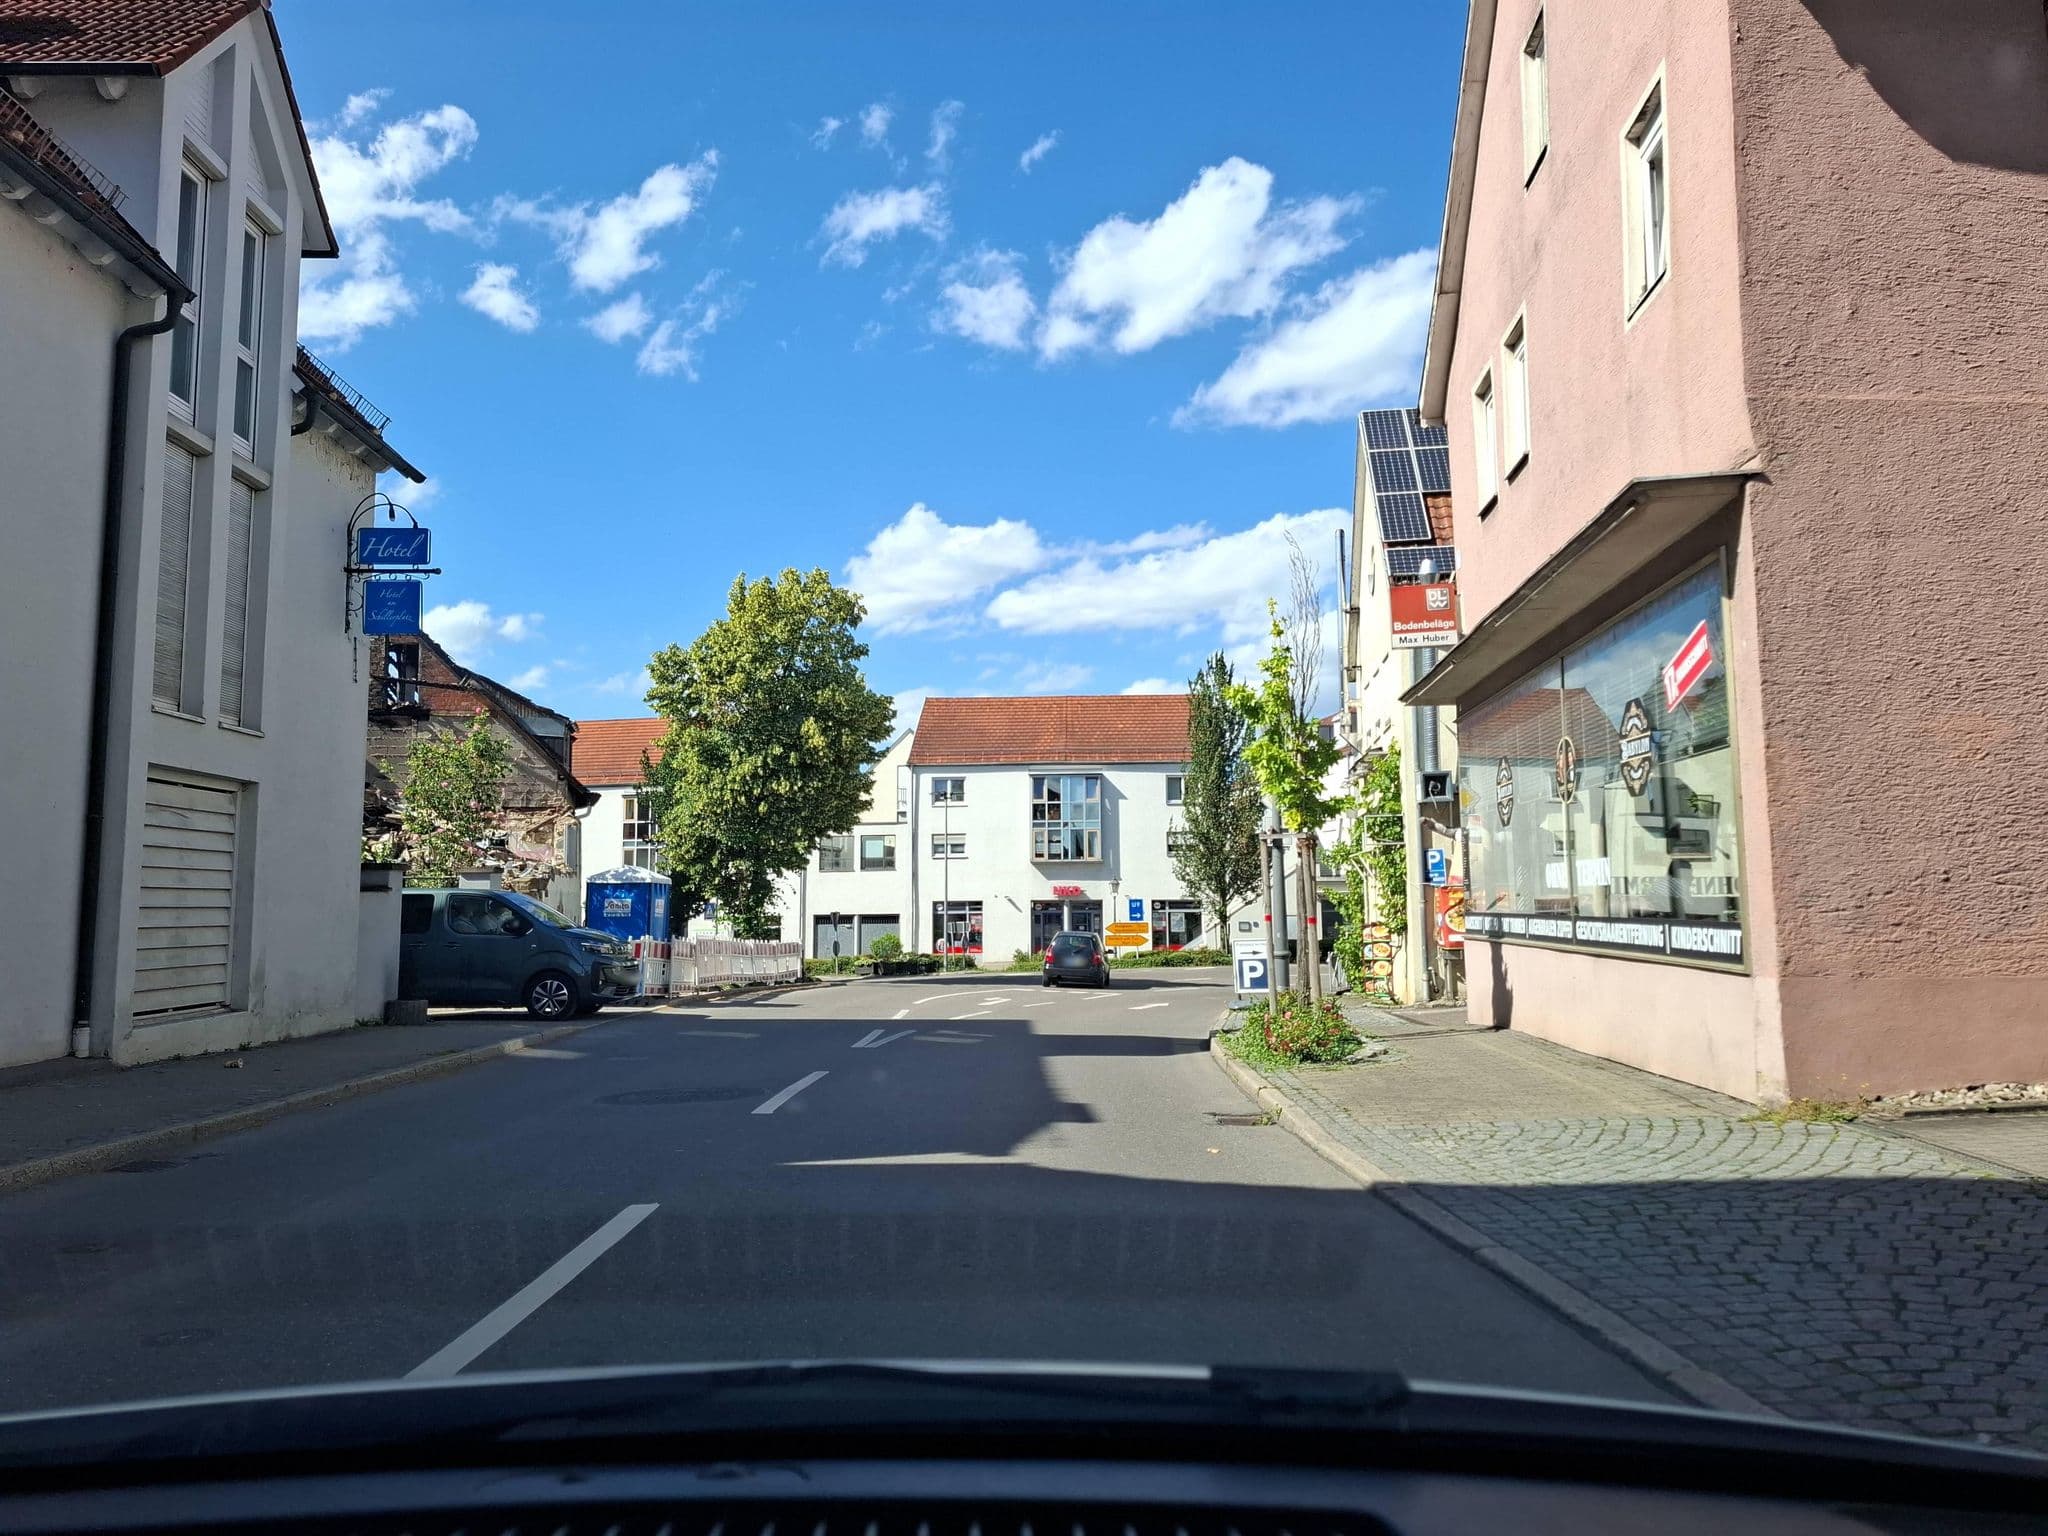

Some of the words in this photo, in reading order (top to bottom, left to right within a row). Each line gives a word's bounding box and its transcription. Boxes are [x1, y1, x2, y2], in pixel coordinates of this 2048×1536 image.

[362, 533, 425, 558] Hotel
[379, 587, 406, 599] Hotel
[1393, 619, 1455, 631] Bodenbeläge
[1399, 635, 1418, 644] Max
[1422, 634, 1450, 643] Huber
[1426, 851, 1441, 872] P
[1671, 926, 1742, 955] KINDERSCHNITT
[1242, 960, 1264, 988] P
